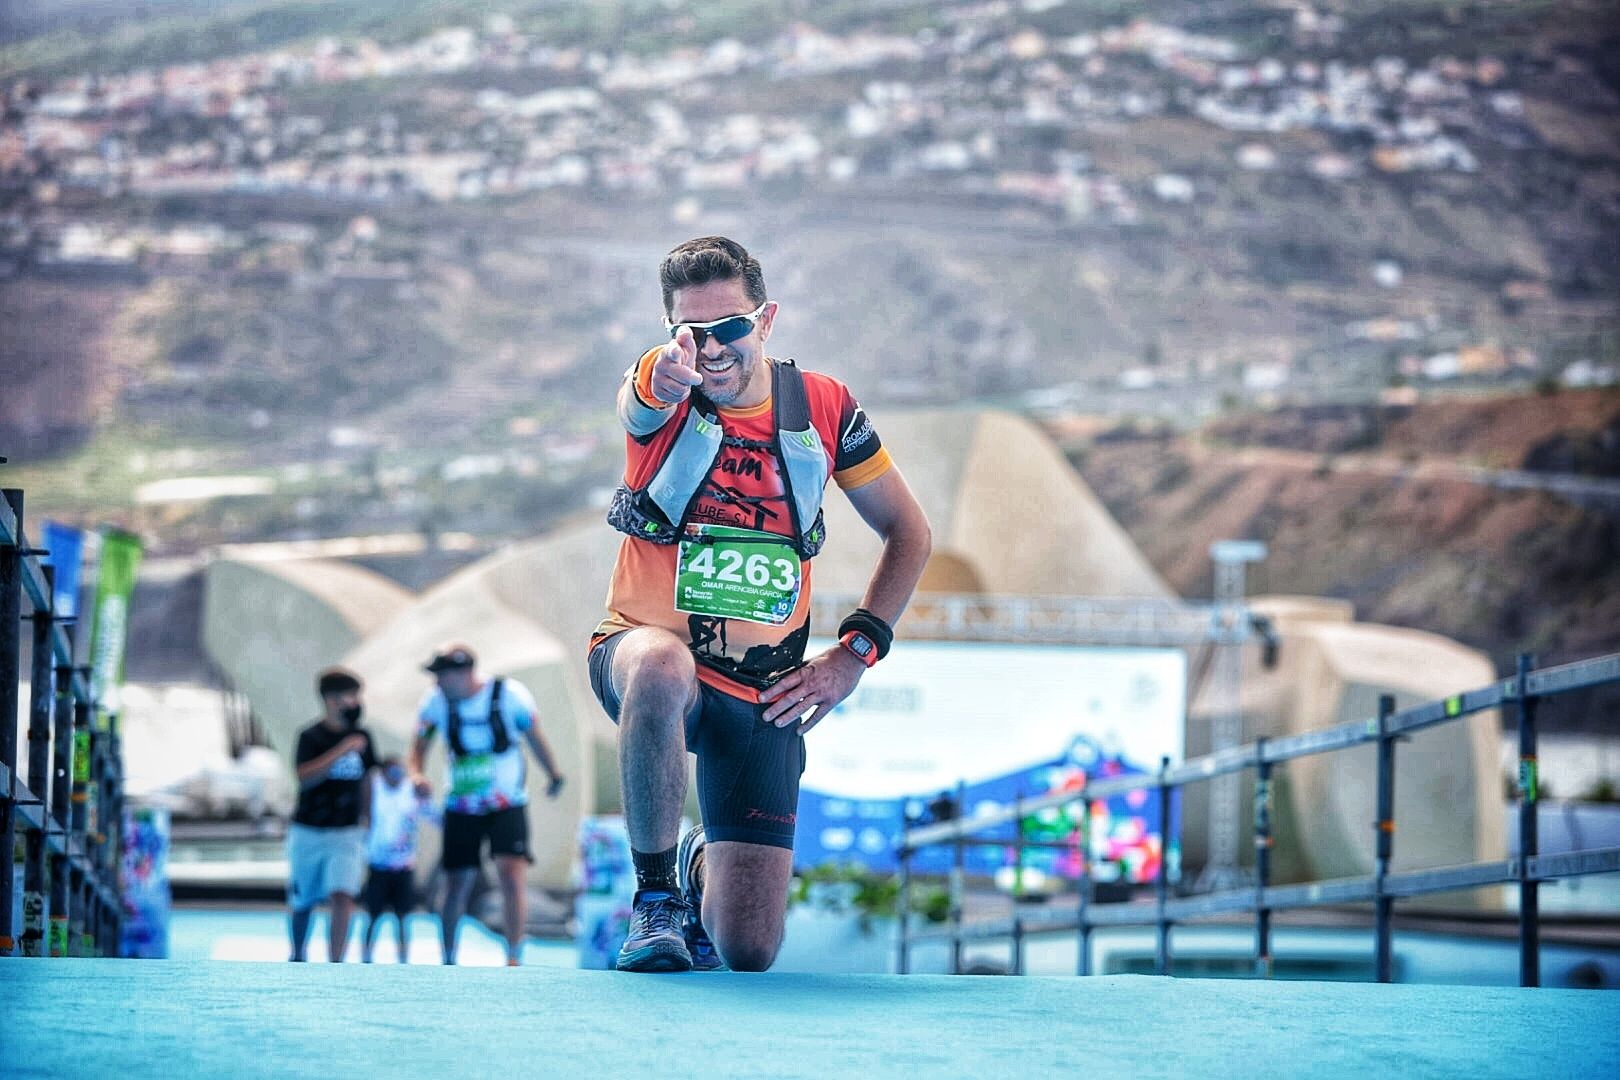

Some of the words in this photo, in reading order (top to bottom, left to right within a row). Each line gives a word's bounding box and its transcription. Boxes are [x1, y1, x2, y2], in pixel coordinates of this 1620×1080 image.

[688, 547, 796, 591] 4263
[701, 580, 724, 591] OMAR
[724, 583, 759, 596] ARENCIBIA
[777, 602, 788, 611] 10
